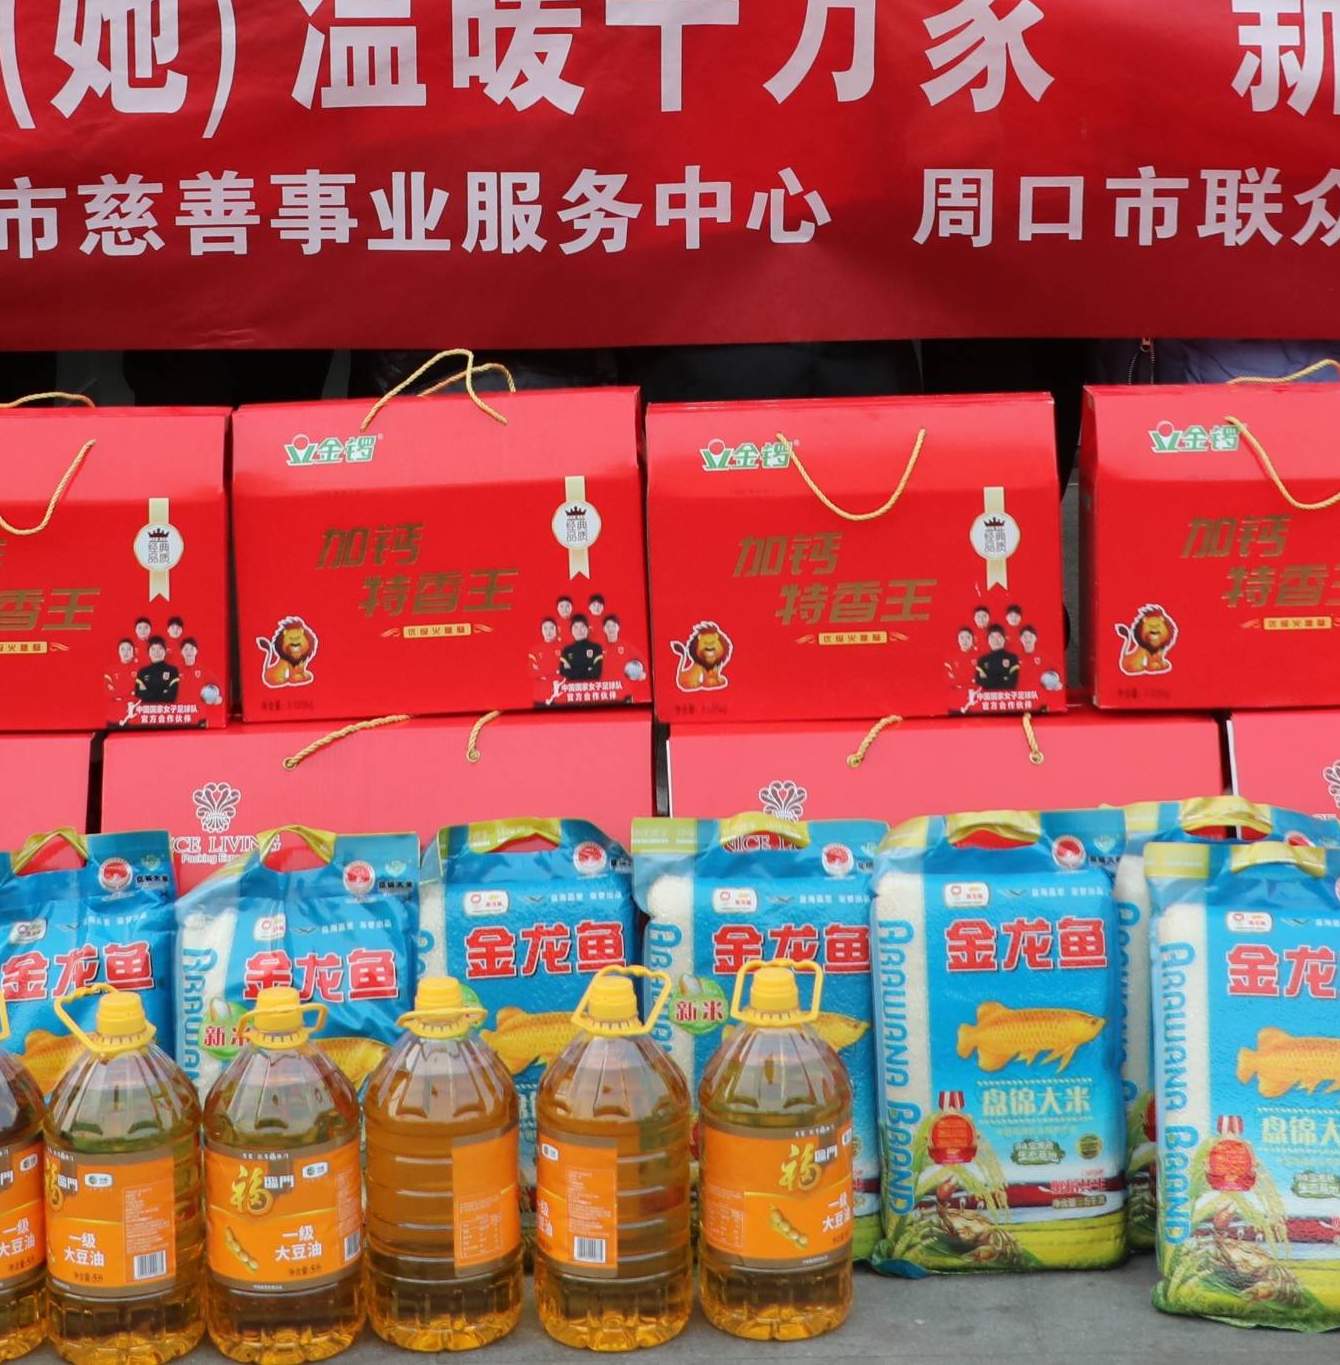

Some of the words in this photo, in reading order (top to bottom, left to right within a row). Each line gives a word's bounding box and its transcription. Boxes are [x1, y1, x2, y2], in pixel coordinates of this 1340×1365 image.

[315, 522, 424, 568] 加钙
[732, 532, 844, 577] 加钙
[1181, 514, 1291, 558] 加钙
[358, 568, 519, 616] 特香王
[775, 578, 939, 625] 特香王
[465, 921, 626, 978] 金龙鱼
[712, 924, 870, 975] 金龙鱼
[945, 916, 1108, 972] 金龙鱼
[0, 941, 155, 1002] 金龙鱼
[242, 950, 398, 1002] 金龙鱼
[676, 1001, 722, 1021] 新米
[983, 1085, 1091, 1116] 盘锦大米
[886, 1099, 922, 1216] BRAND
[1165, 1124, 1199, 1245] BRAND
[69, 1232, 96, 1248] 一级
[275, 1242, 322, 1262] 大豆油
[282, 1225, 314, 1241] 一级
[64, 1247, 105, 1267] 大豆油
